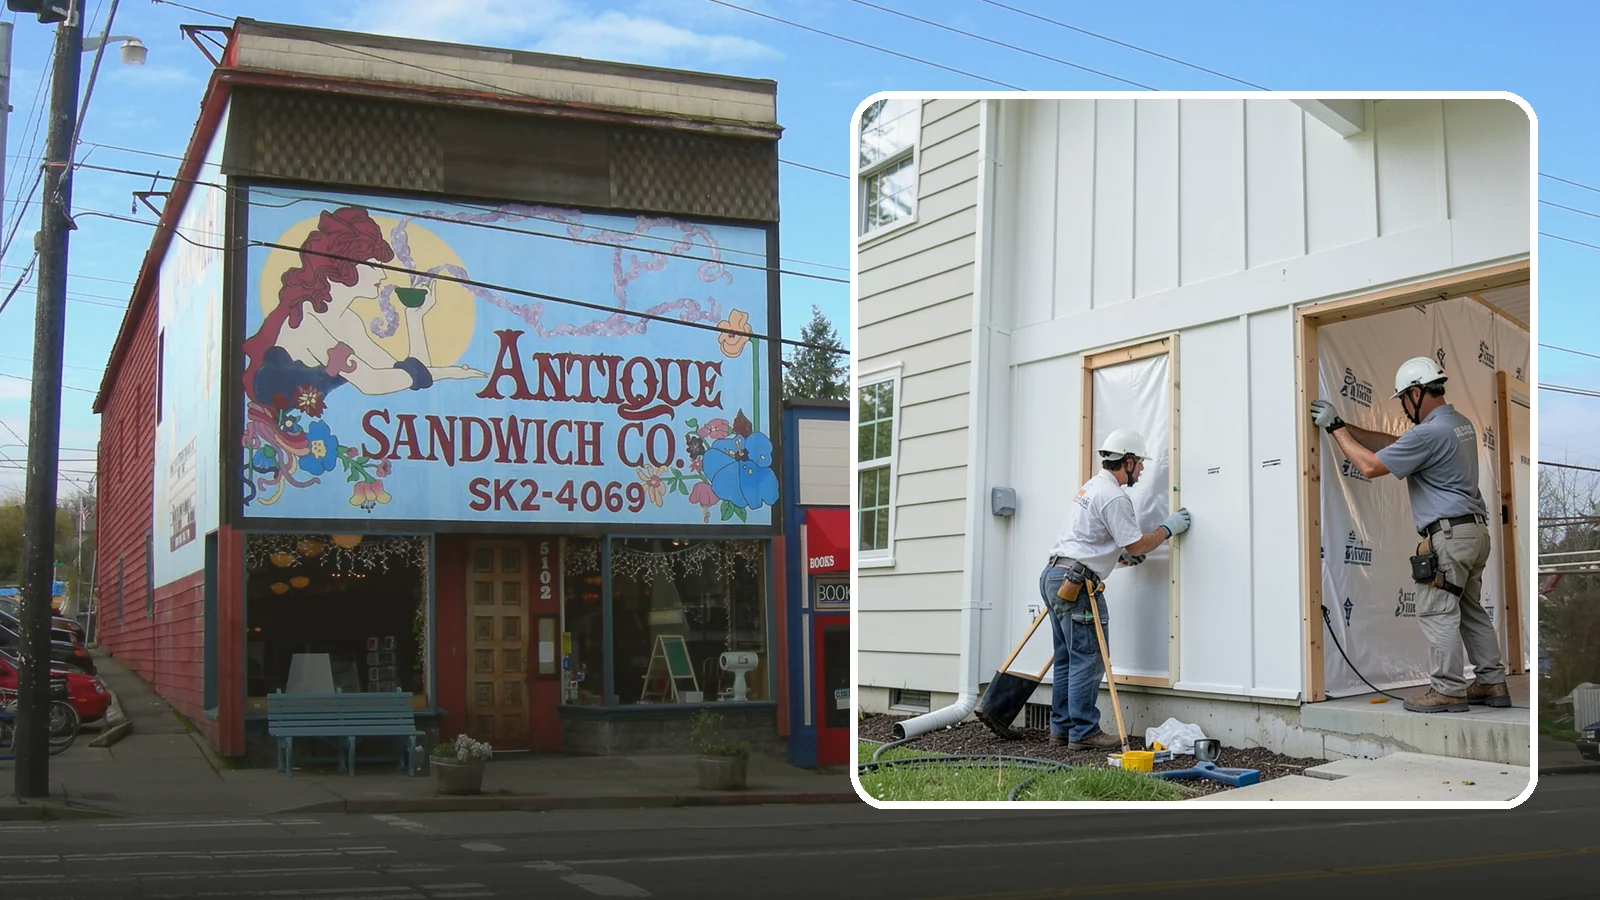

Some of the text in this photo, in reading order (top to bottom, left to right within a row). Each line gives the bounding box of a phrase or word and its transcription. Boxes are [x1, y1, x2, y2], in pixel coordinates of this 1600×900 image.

[476, 329, 723, 420] ANTIQUE
[361, 408, 684, 469] SANDWICH CO.
[469, 477, 646, 513] SK2-4069
[540, 541, 551, 600] 5102
[809, 555, 835, 569] BOOKS
